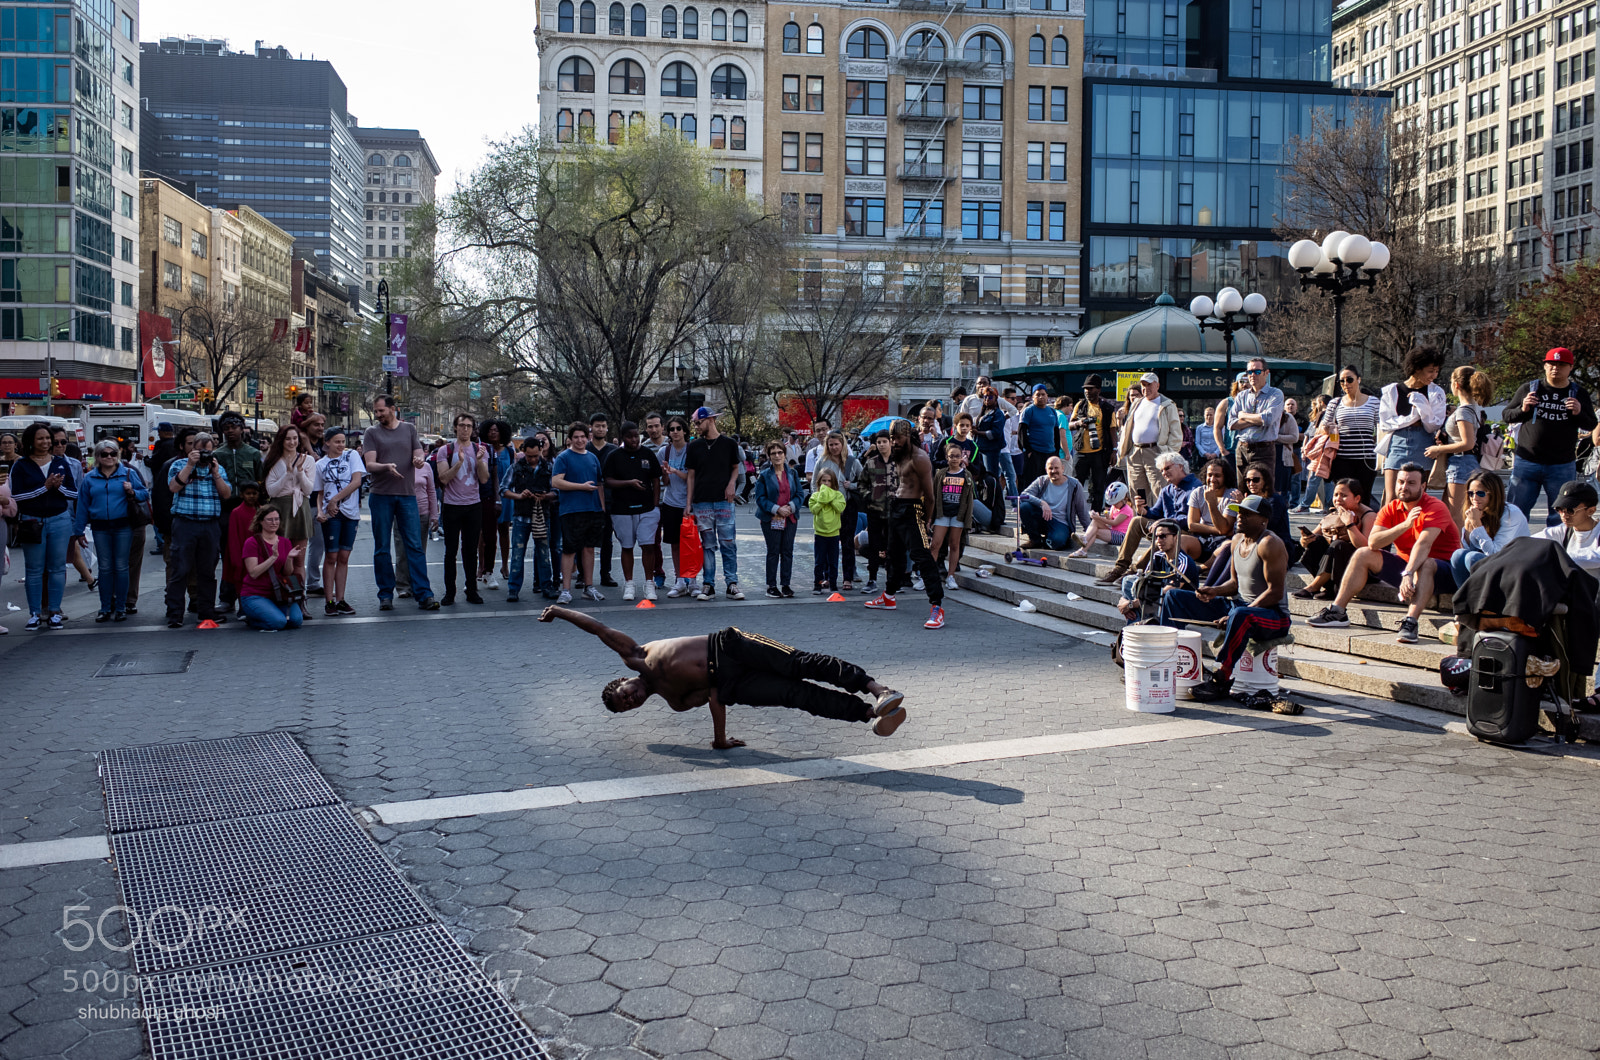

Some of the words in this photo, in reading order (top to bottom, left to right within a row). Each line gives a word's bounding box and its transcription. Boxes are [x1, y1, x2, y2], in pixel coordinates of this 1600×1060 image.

[1181, 375, 1212, 386] Union
[1538, 401, 1567, 412] MERIC
[1537, 408, 1569, 421] EAGLE
